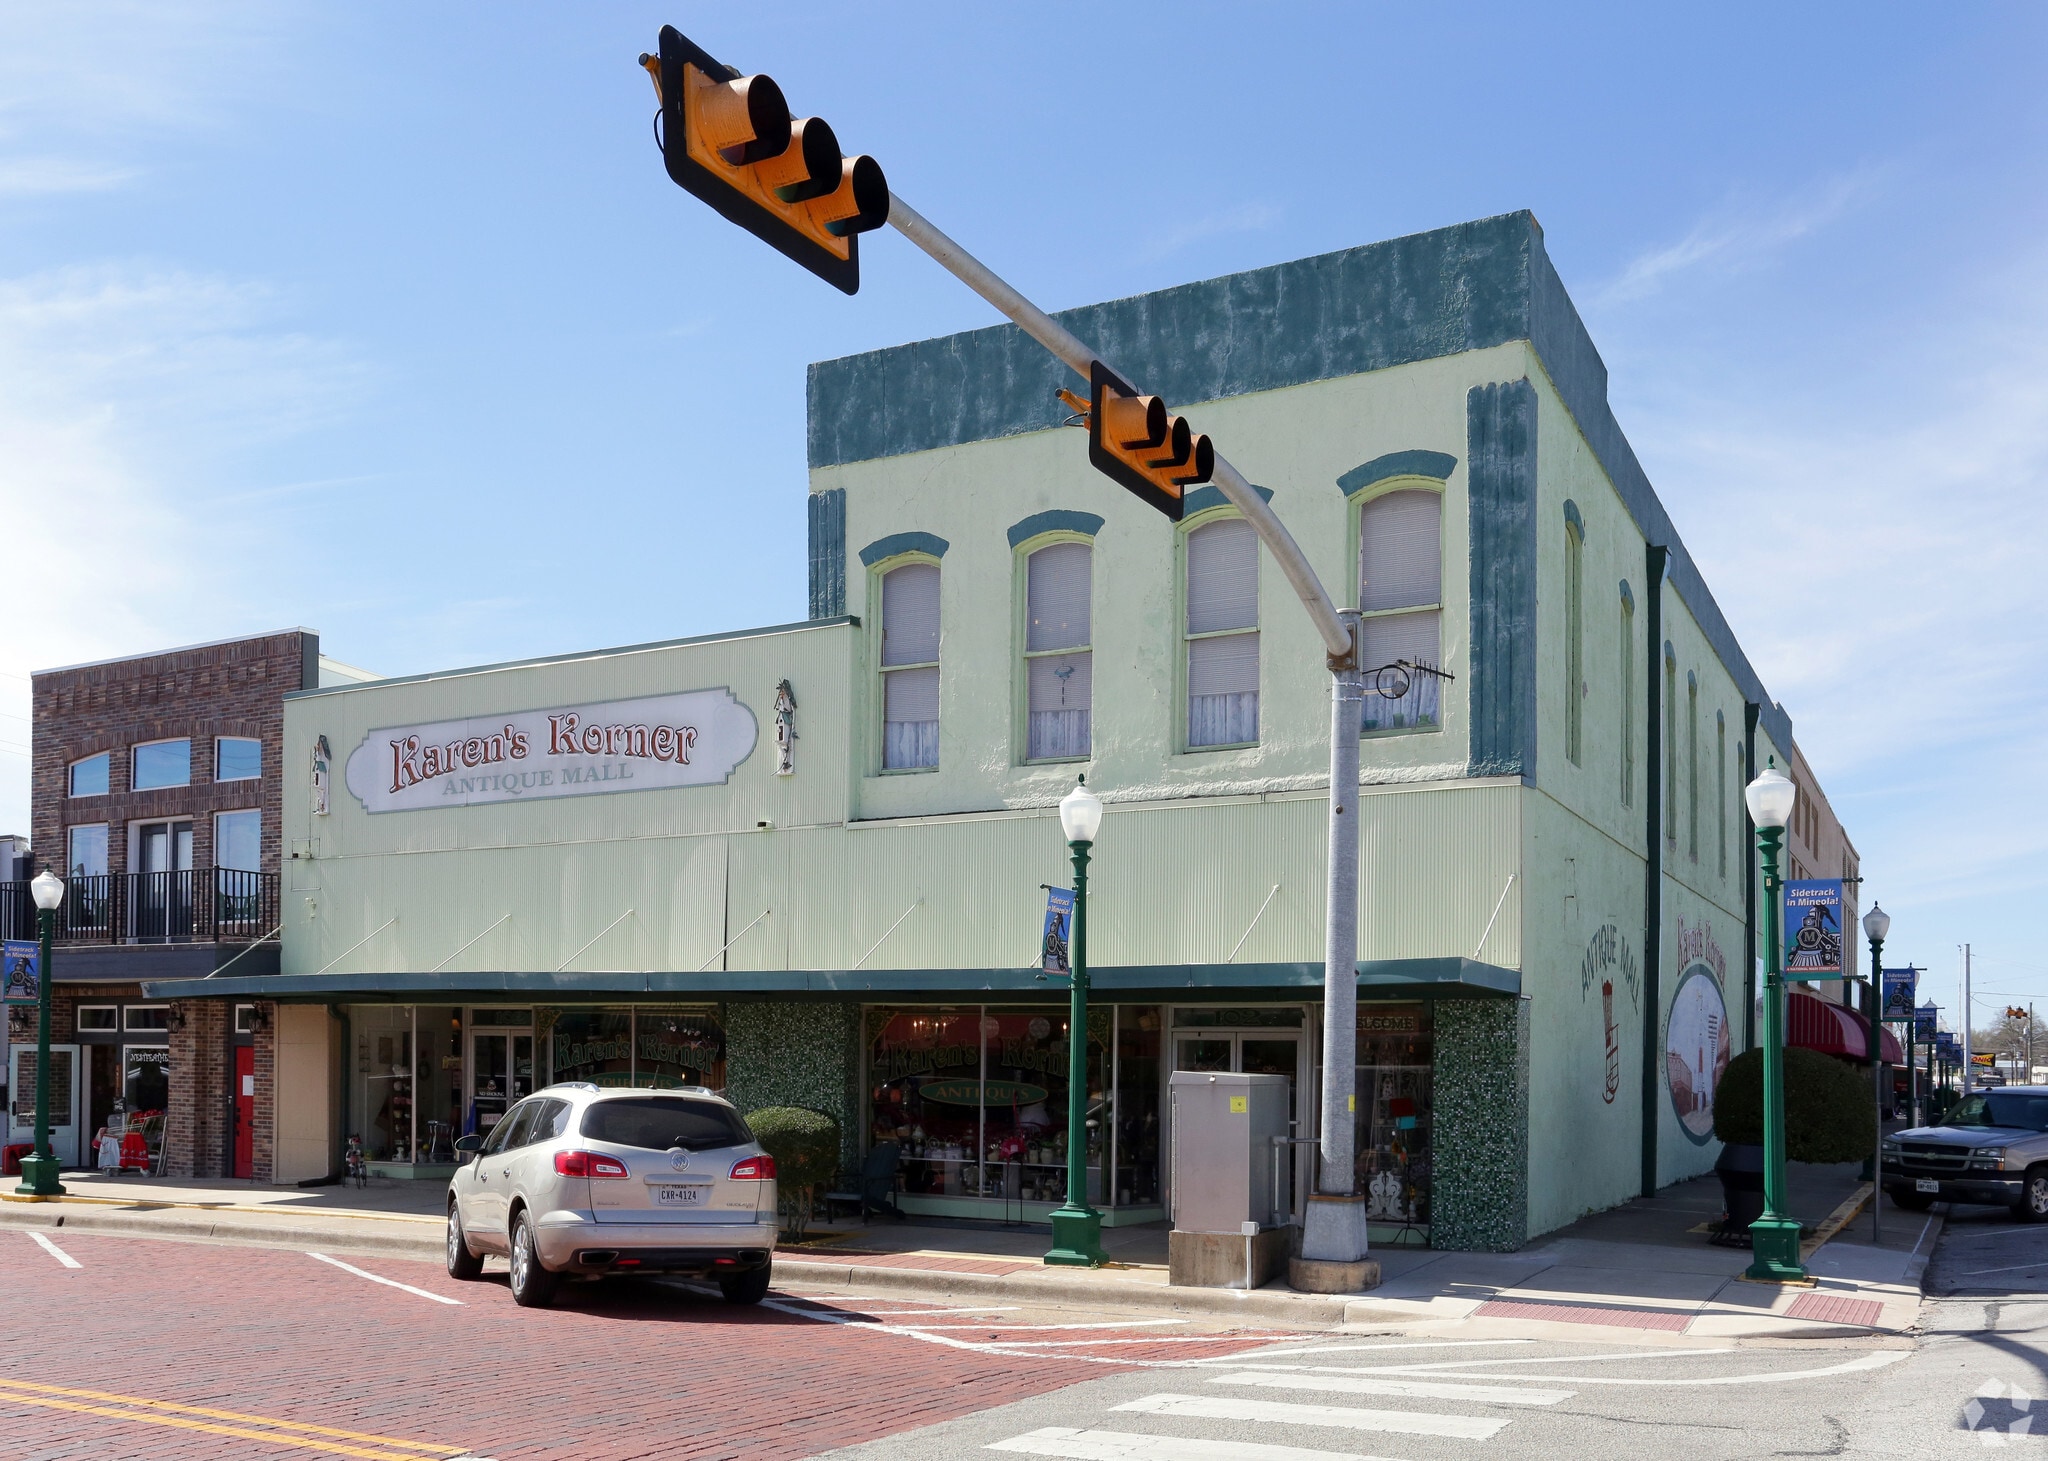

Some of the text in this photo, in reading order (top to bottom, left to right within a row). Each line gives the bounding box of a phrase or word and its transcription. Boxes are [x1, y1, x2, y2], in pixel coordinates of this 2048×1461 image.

[389, 712, 698, 794] Karen's Korner
[442, 762, 635, 797] ANTIQUE MALL
[1791, 889, 1834, 897] Sidetrack
[1798, 897, 1839, 906] Mineola!
[1804, 931, 1816, 942] M
[1581, 923, 1640, 1016] ANTIQUE MALL
[1214, 1010, 1261, 1024] 102
[1357, 1017, 1413, 1029] ELCOME
[130, 1053, 169, 1063] NESTFEATHE
[554, 1033, 718, 1075] Karen's Korner
[888, 1037, 1069, 1081] Karen's Korn
[595, 1078, 673, 1088] COLLETILES
